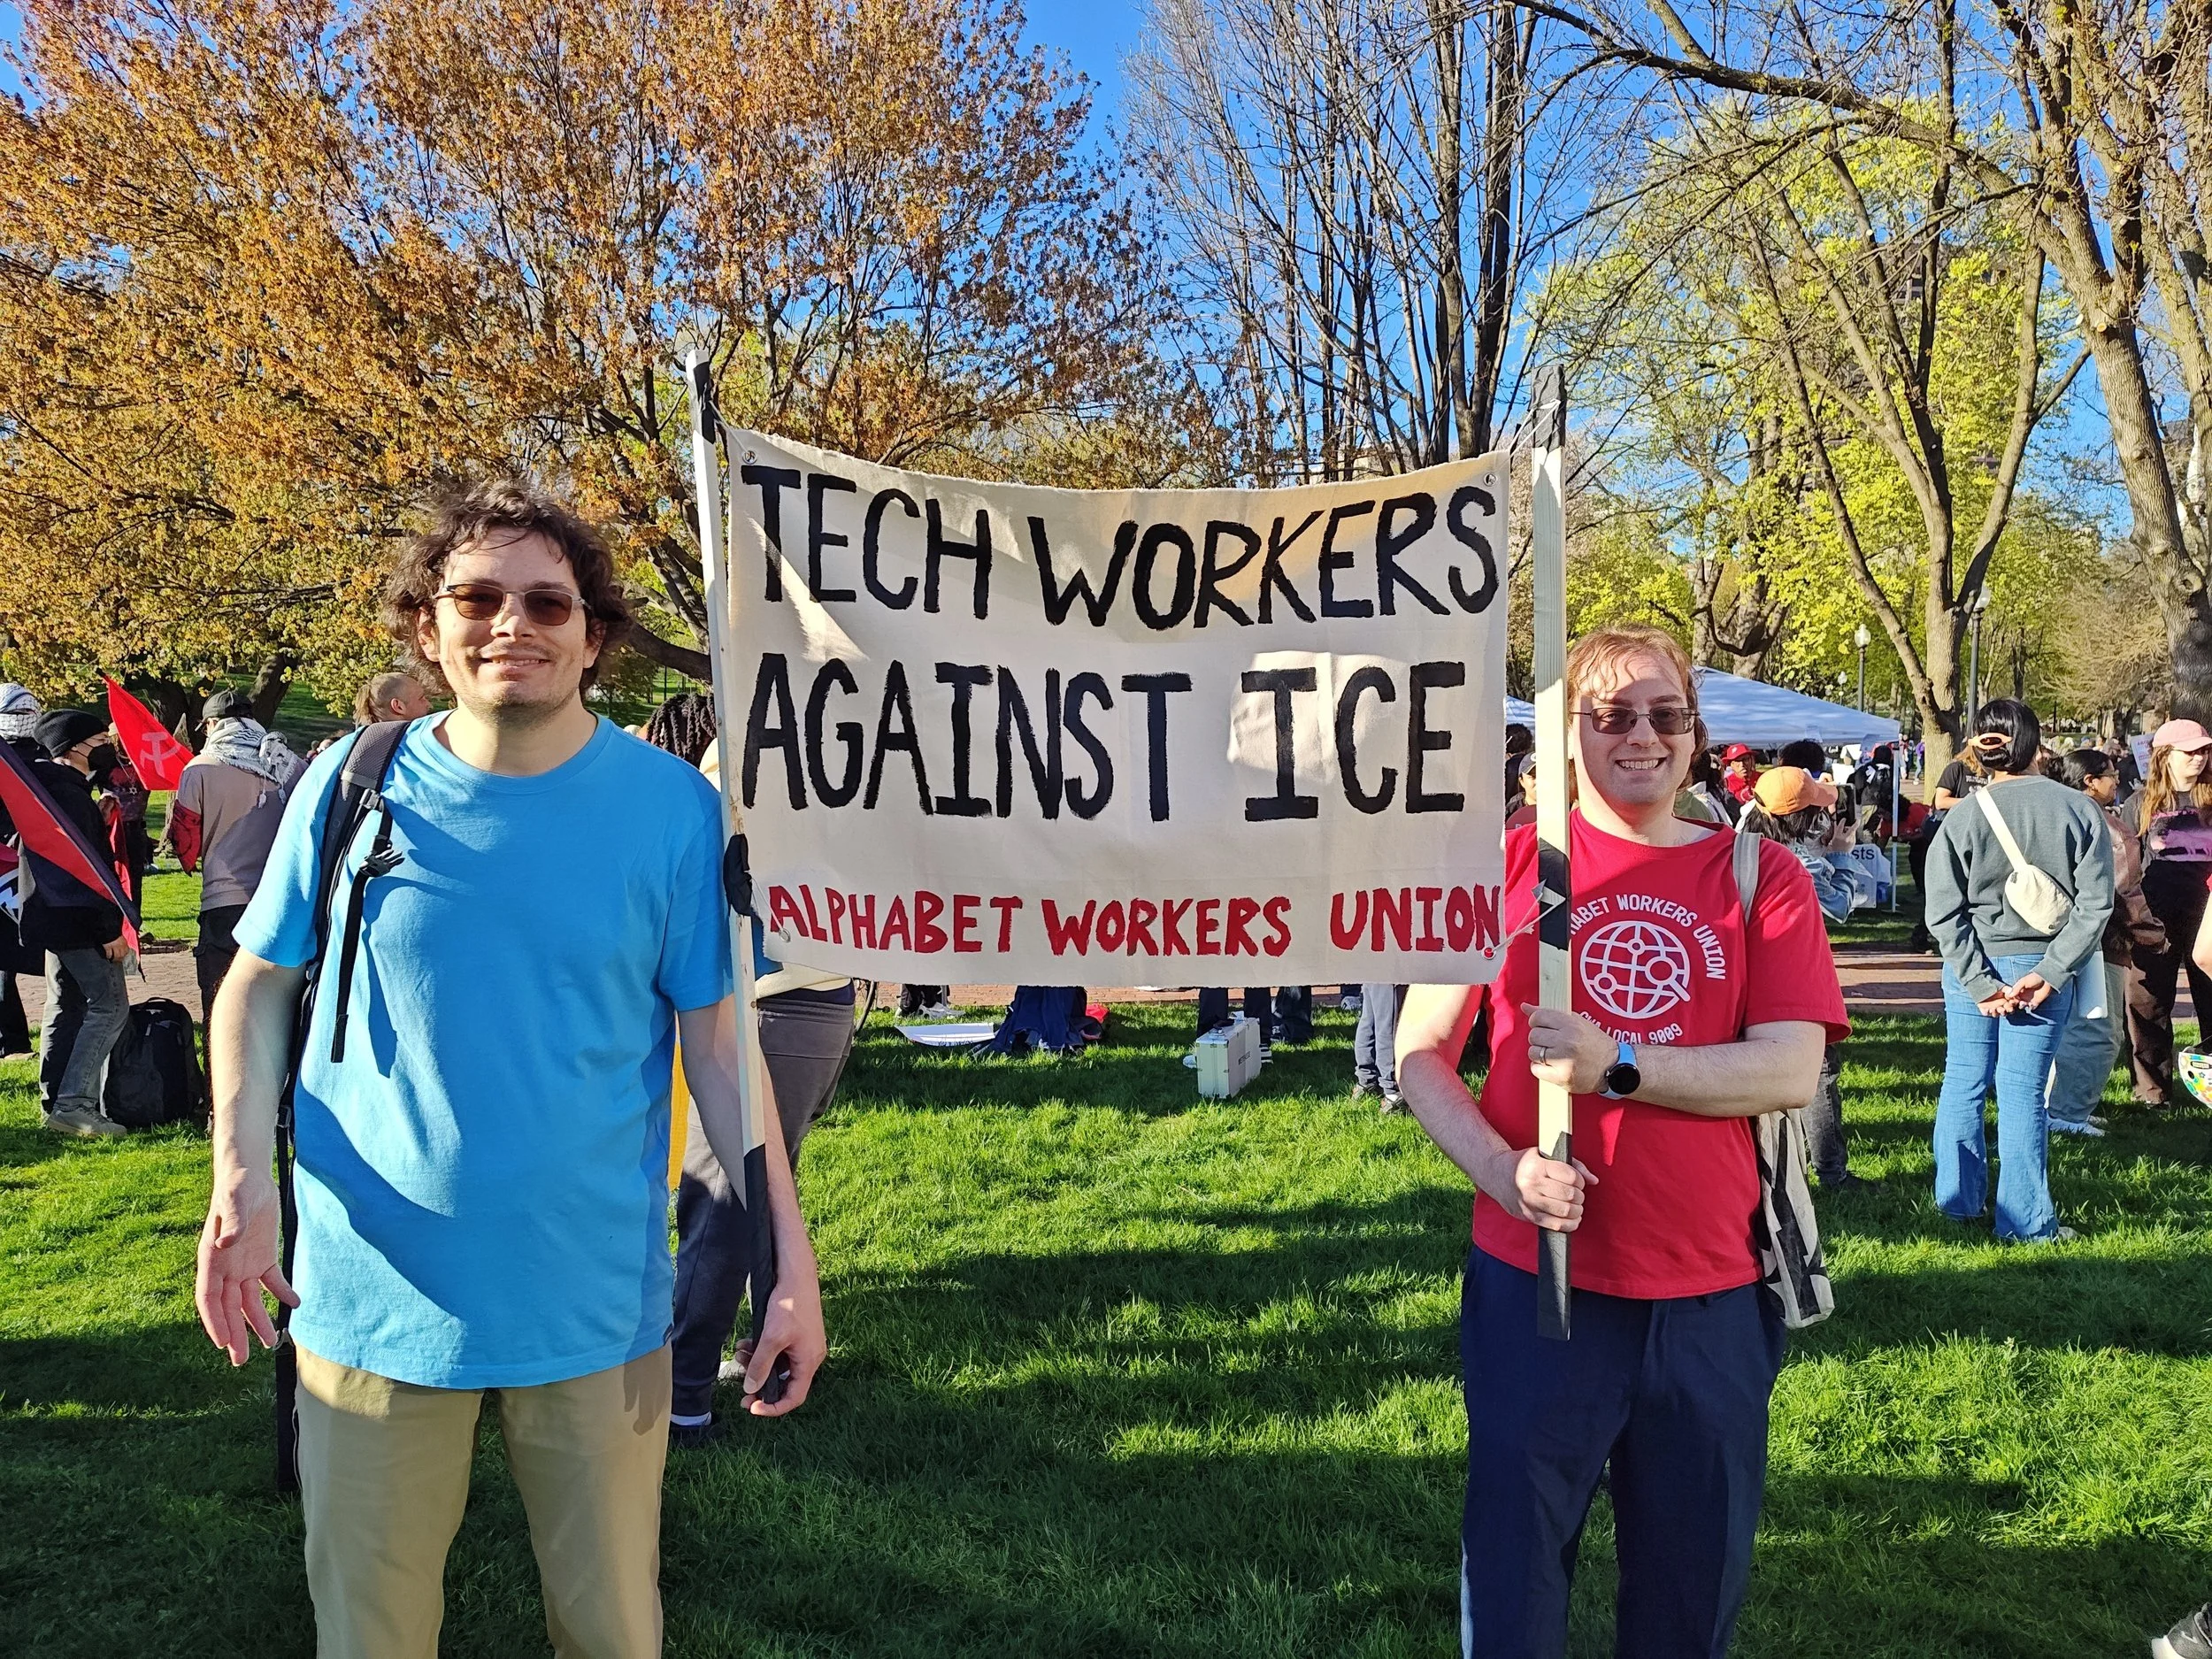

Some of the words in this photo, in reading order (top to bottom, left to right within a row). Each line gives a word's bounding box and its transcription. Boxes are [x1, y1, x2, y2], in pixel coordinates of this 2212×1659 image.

[741, 465, 993, 619] TECH
[1026, 486, 1500, 630] WORKERS
[741, 652, 1194, 822] AGAINST
[1240, 660, 1466, 822] ICE
[768, 884, 1023, 953] ALPHABET
[1041, 895, 1292, 956] WORKERS
[1330, 884, 1501, 953] UNION
[1616, 894, 1699, 928] WORKERS
[1693, 925, 1726, 979] UNION
[1648, 1023, 1683, 1045] 9009
